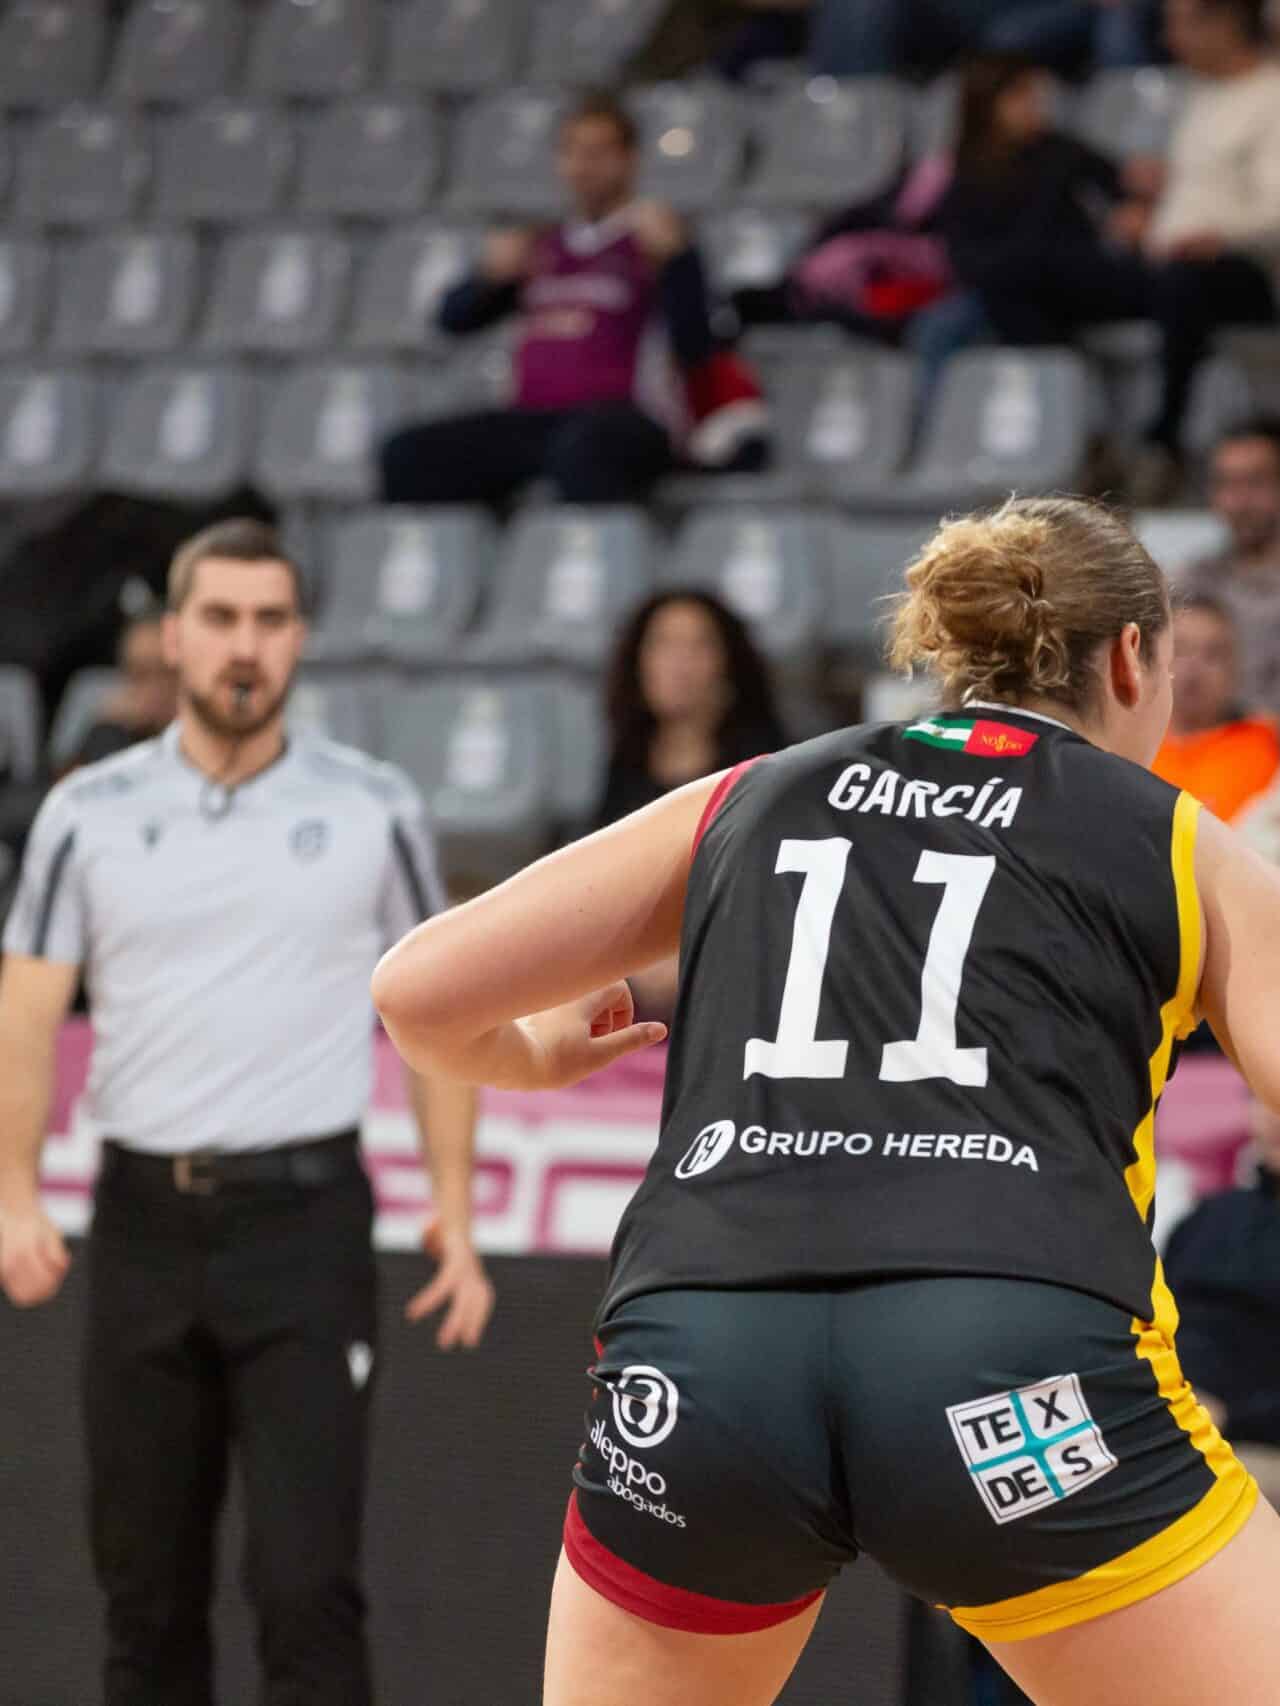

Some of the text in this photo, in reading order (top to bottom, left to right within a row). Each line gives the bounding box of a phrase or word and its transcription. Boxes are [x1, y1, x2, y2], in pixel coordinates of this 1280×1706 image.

[828, 763, 1024, 827] GARCÍA
[743, 837, 997, 1087] 11
[882, 1131, 1039, 1171] HEREDA
[590, 1419, 666, 1495] aleppo
[607, 1475, 687, 1528] abogados
